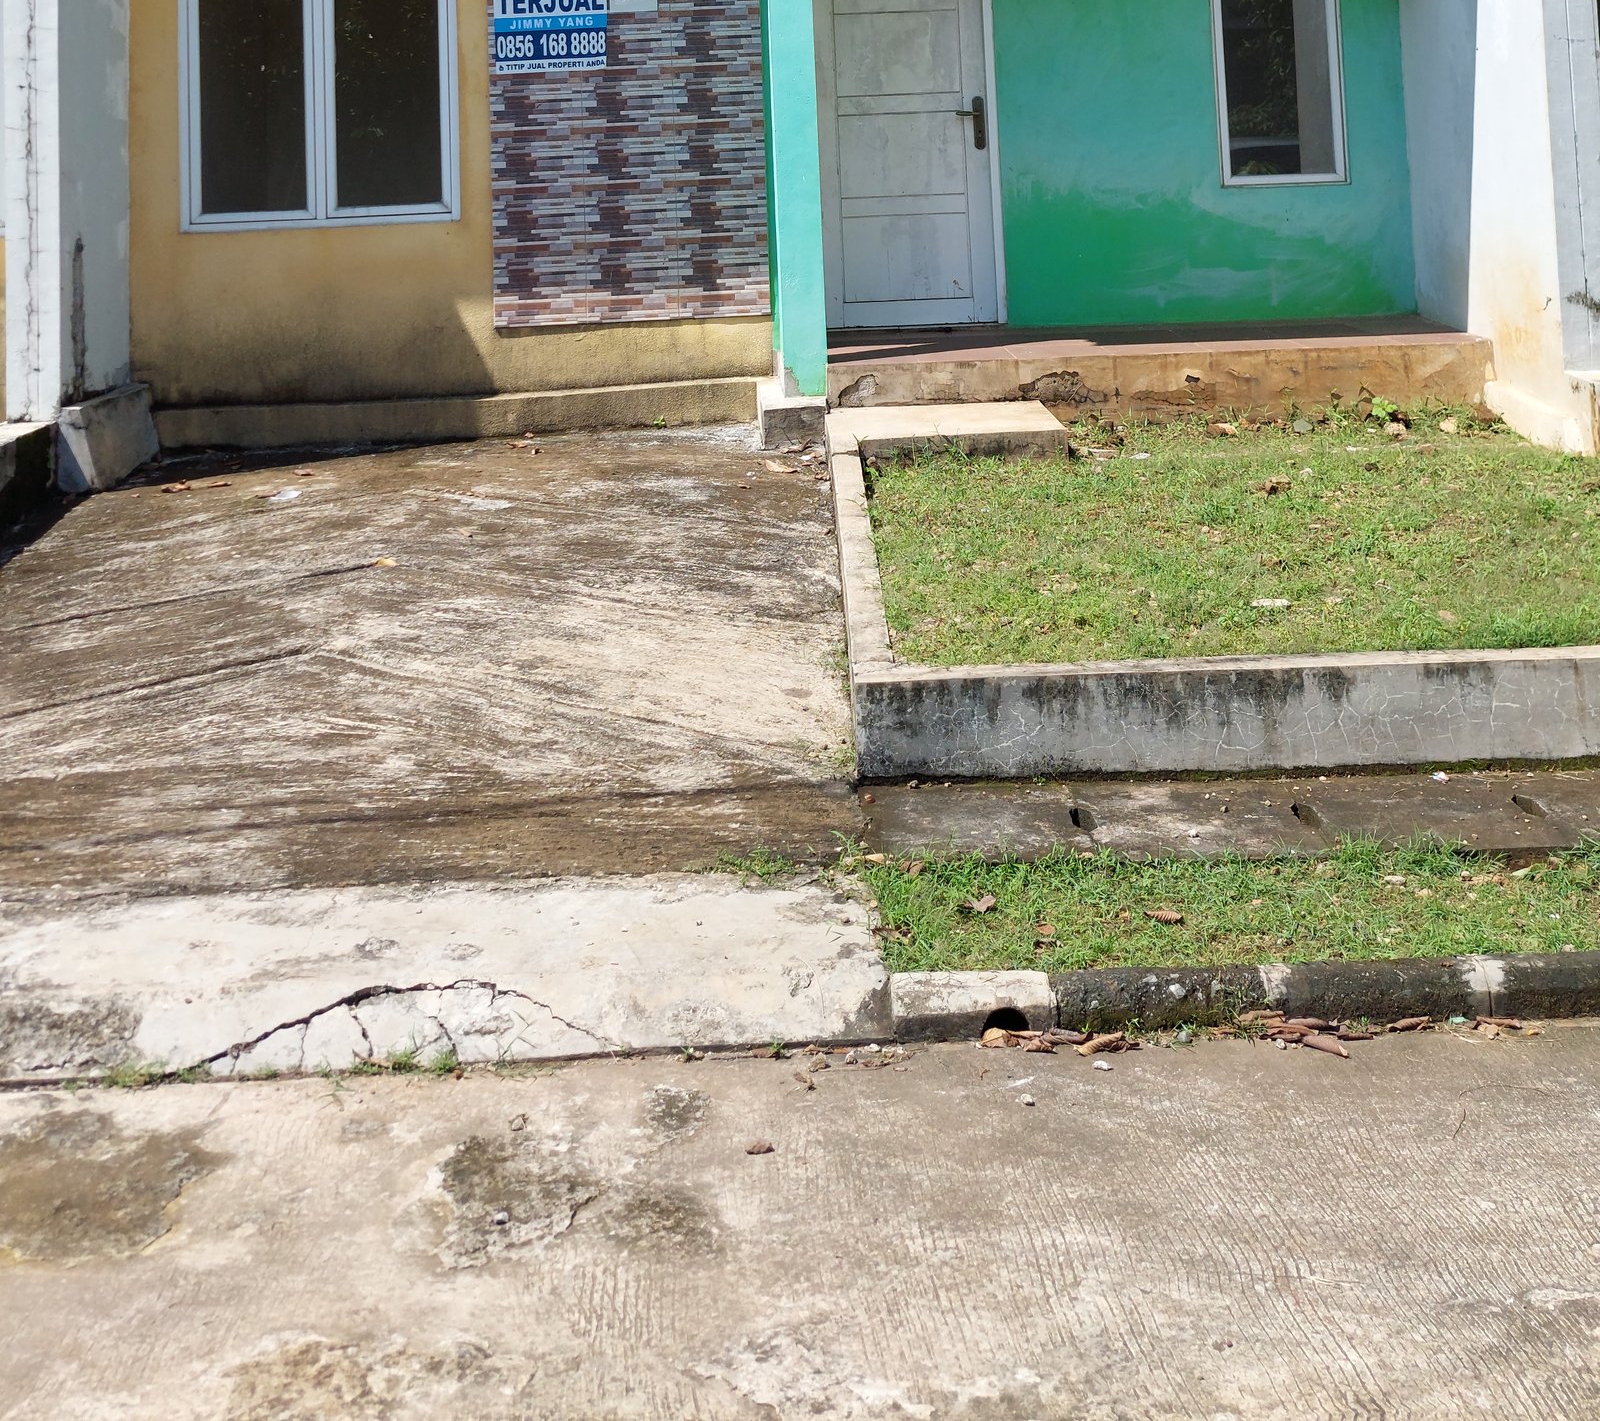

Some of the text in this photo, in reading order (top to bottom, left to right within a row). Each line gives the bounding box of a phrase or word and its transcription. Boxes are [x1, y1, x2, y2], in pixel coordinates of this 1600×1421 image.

[510, 17, 594, 30] JIMMY YANG
[497, 31, 606, 58] 0856 168 8888
[527, 62, 546, 70] JUAL
[548, 60, 584, 69] PROPERTI
[586, 59, 605, 67] ANDA
